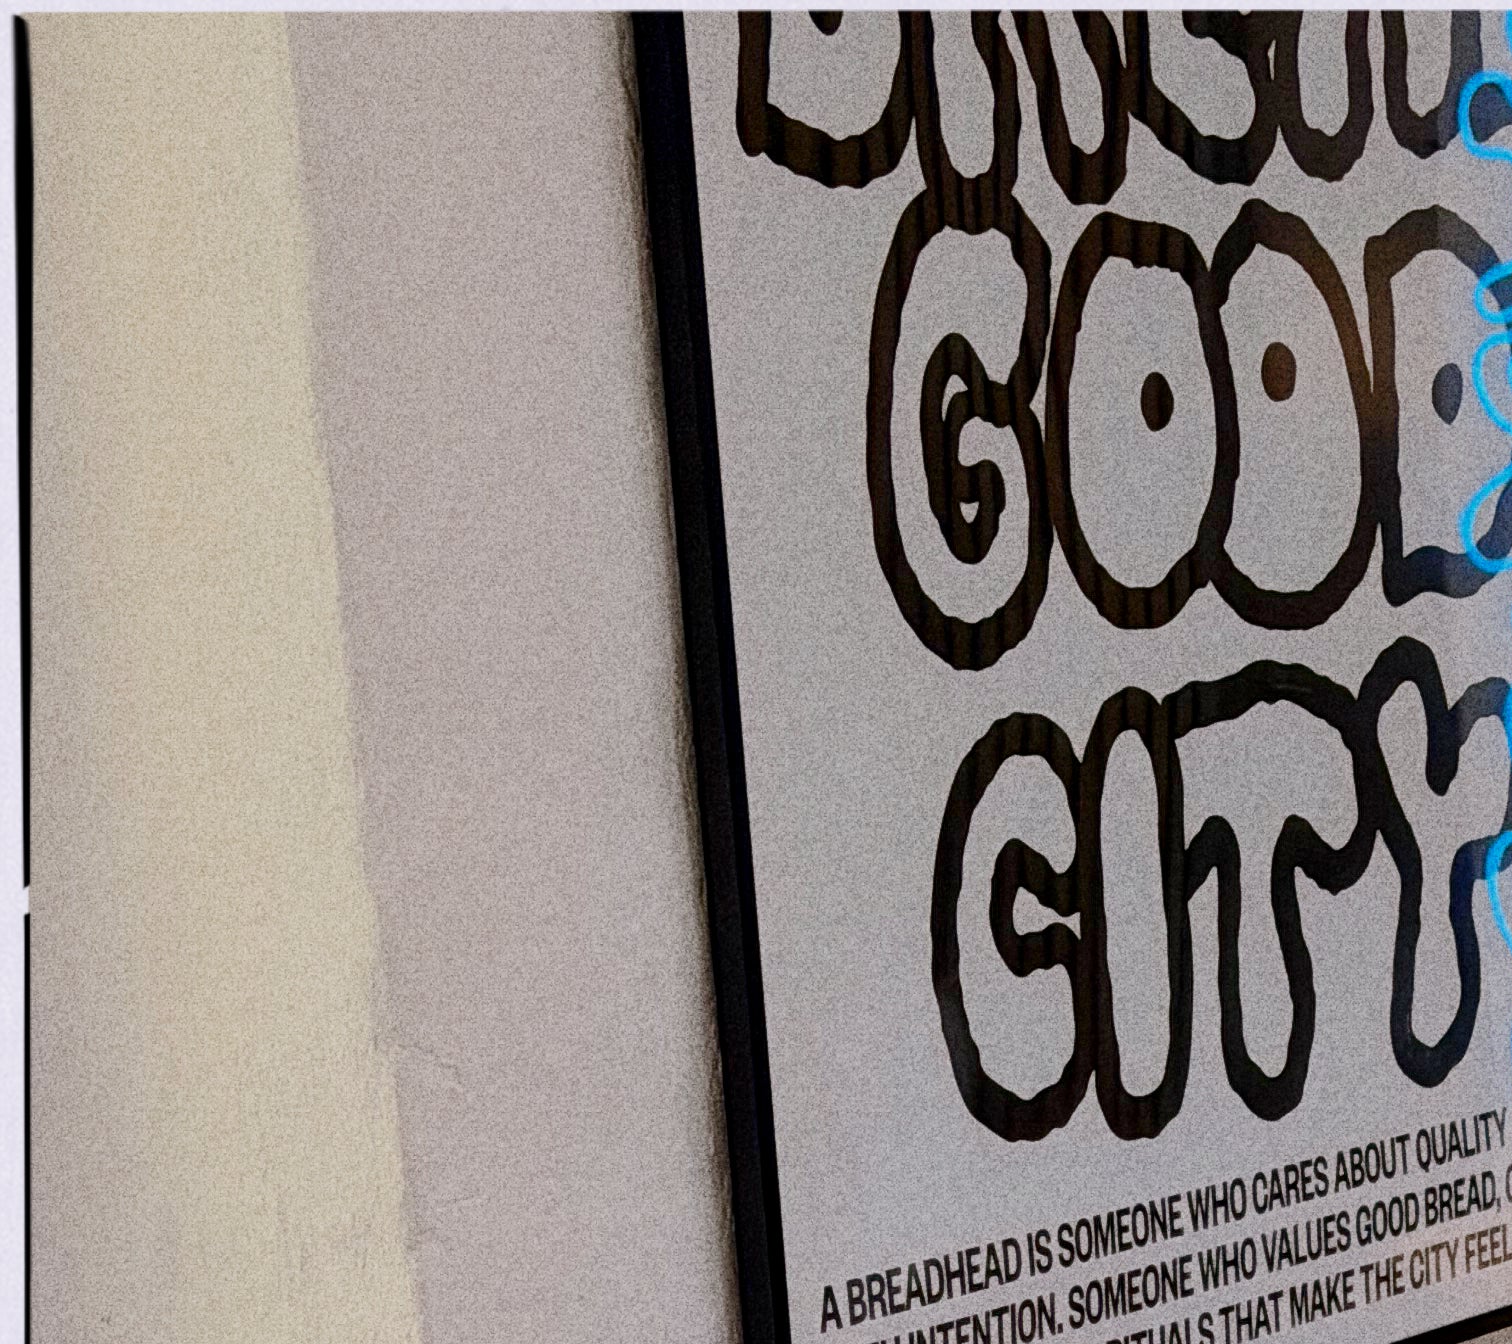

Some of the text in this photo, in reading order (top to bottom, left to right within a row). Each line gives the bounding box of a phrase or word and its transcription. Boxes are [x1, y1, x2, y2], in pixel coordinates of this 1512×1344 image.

[820, 1284, 843, 1334] A
[846, 1236, 1023, 1327] BREADHEAD
[1027, 1228, 1054, 1277] IS
[1057, 1194, 1184, 1268] SOMEONE
[1187, 1177, 1248, 1233] WHO
[1252, 1155, 1330, 1215] CARES
[1334, 1133, 1411, 1193] ABOUT
[1415, 1106, 1507, 1173] QUALITY
[1068, 1253, 1194, 1329] SOMEONE
[1198, 1237, 1257, 1293] WHO
[1261, 1210, 1352, 1274] VALUES
[1356, 1191, 1420, 1247] GOOD
[1424, 1170, 1502, 1228] BREAD,
[1289, 1268, 1357, 1329] MAKE
[1360, 1252, 1406, 1305] THE
[1409, 1237, 1460, 1290] CITY
